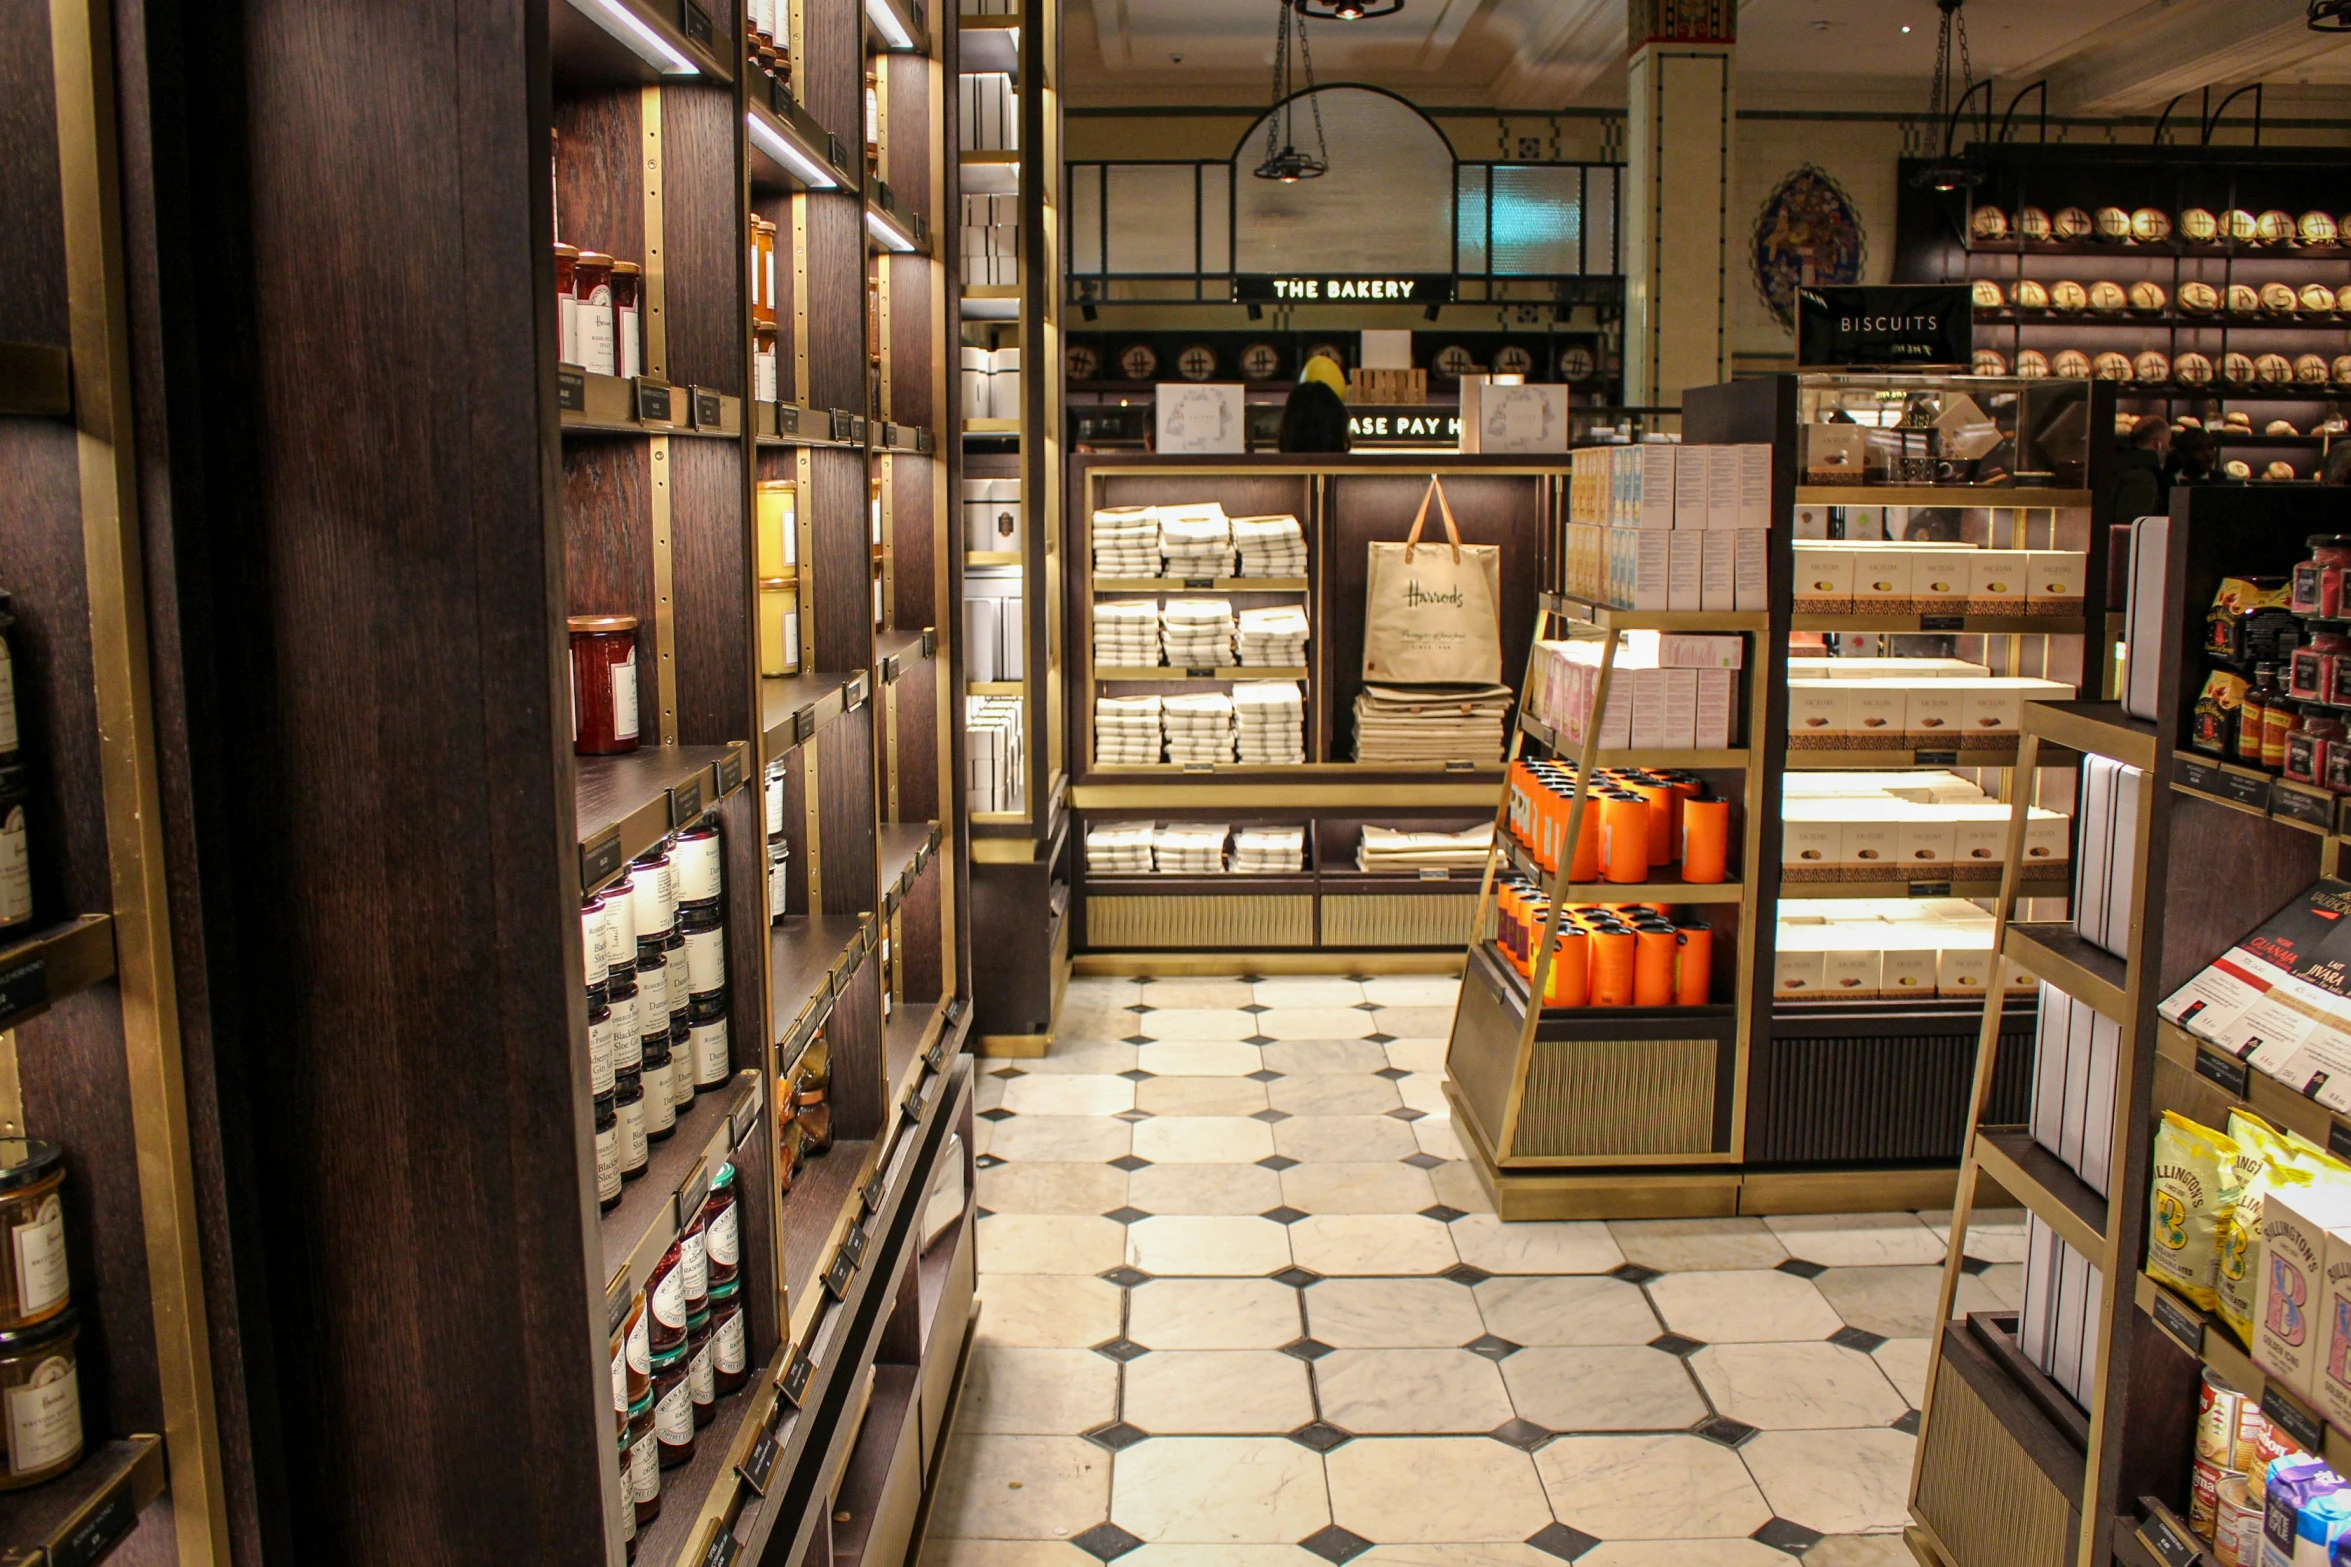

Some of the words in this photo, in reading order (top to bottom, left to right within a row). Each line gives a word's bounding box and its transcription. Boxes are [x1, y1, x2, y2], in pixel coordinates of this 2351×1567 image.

[1273, 280, 1319, 298] THE
[1327, 280, 1415, 298] BAKERY
[1841, 316, 1938, 332] BISCUITS
[1396, 417, 1441, 435] PAY
[1402, 579, 1463, 608] Harrods
[2250, 936, 2299, 965] GUANAJA
[2327, 960, 2345, 970] LAIT
[2307, 963, 2345, 986] JIVARA
[614, 1042, 629, 1051] Sloe
[598, 1173, 612, 1183] Sloe
[2154, 1188, 2188, 1250] B
[2264, 1221, 2319, 1273] BILLINGTON'S
[2264, 1250, 2307, 1347] B
[662, 1429, 681, 1440] TIPTREE
